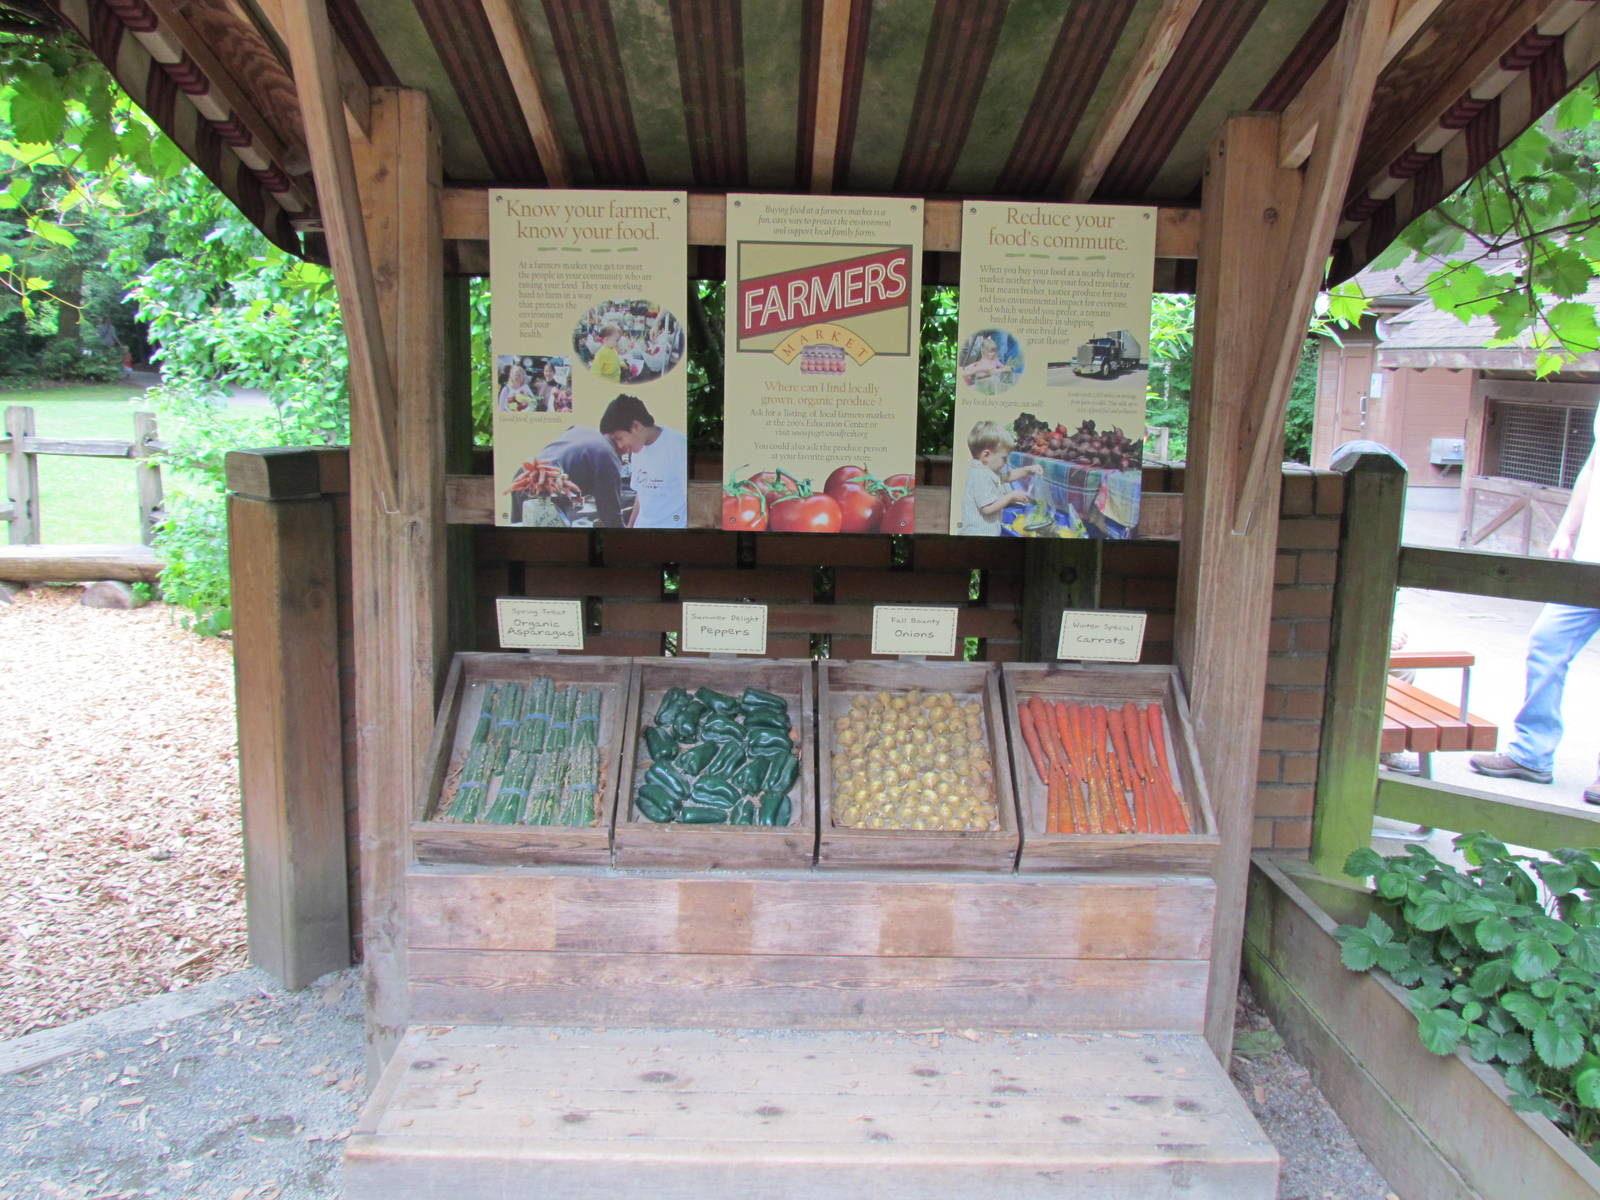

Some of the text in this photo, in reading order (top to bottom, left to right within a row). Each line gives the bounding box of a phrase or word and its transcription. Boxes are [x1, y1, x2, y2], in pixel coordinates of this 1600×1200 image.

[506, 199, 671, 222] Know your farmer,
[1007, 208, 1115, 232] Reduce your
[517, 220, 660, 244] know your food.
[990, 227, 1128, 250] food's commute.
[745, 258, 906, 329] FARMERS
[783, 329, 867, 356] MARKET
[764, 381, 798, 392] Where
[827, 382, 846, 393] find
[848, 383, 879, 396] locally
[798, 395, 832, 407] organic
[513, 619, 560, 629] Organic
[701, 626, 750, 637] Peppers
[507, 628, 575, 639] Asparagus
[895, 629, 935, 638] Onions
[1077, 635, 1126, 645] Carrots
